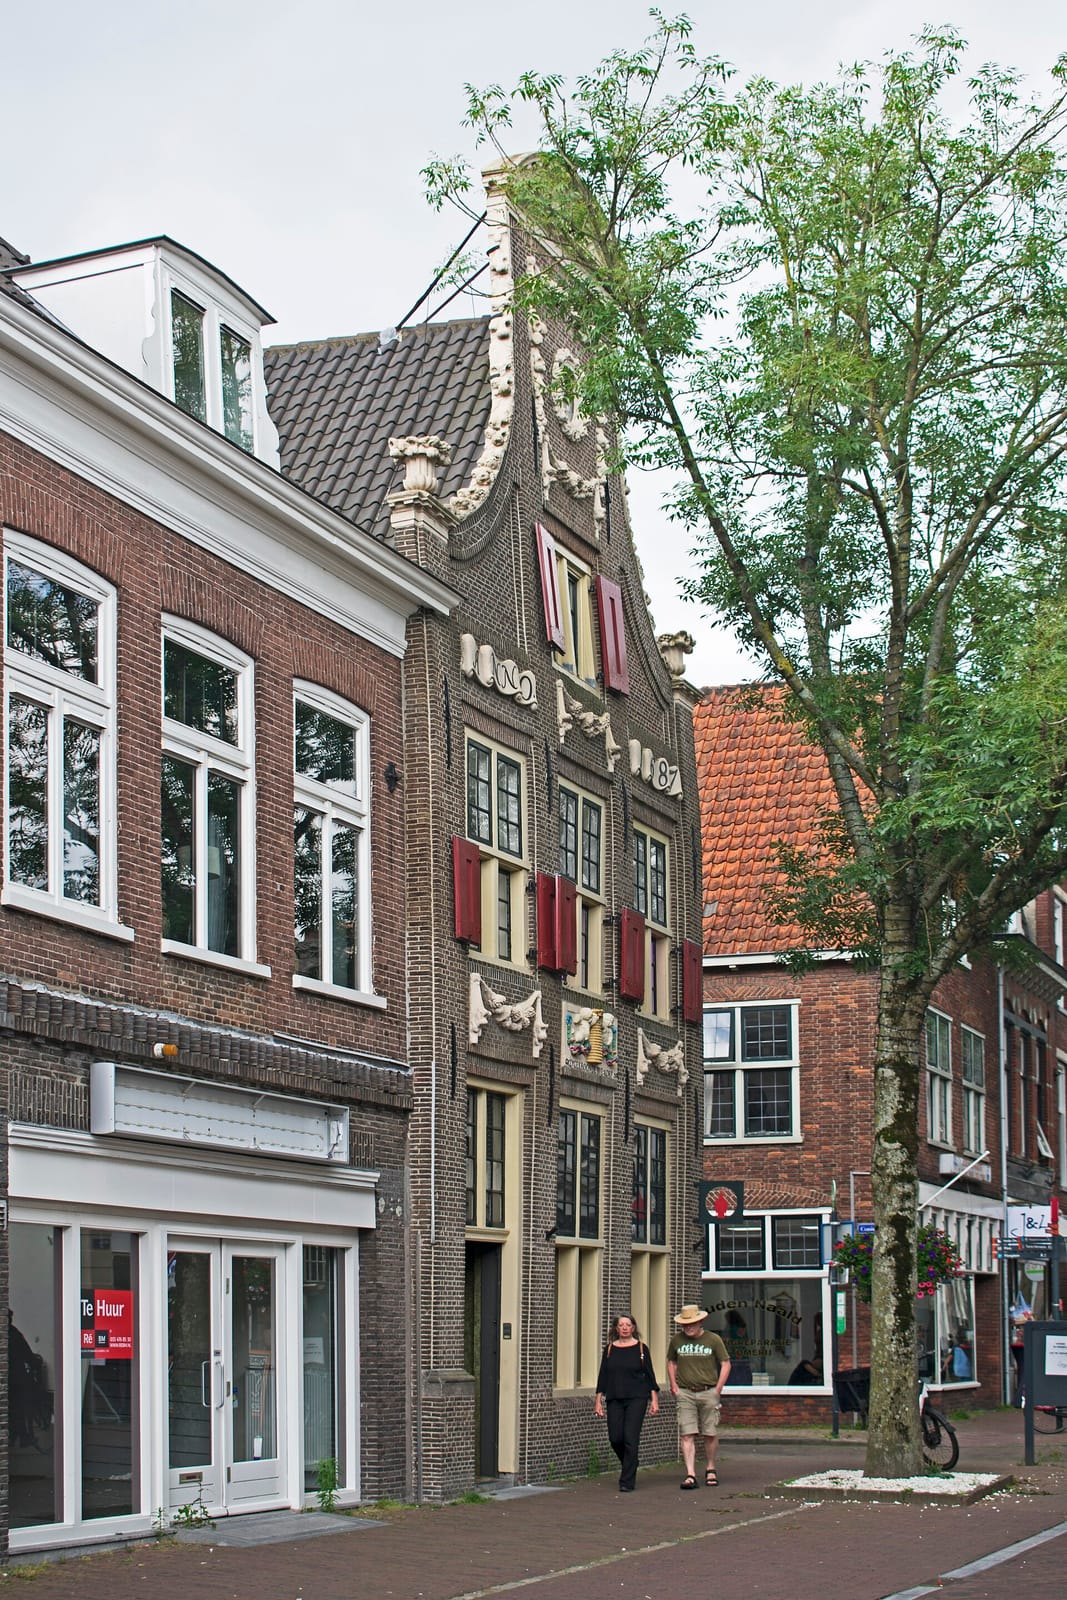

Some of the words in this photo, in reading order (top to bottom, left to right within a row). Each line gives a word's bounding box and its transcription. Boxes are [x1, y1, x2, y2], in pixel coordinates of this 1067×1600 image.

[81, 1299, 94, 1317] Te
[96, 1299, 124, 1318] Huur
[706, 1300, 748, 1314] uden
[755, 1299, 803, 1325] Naald
